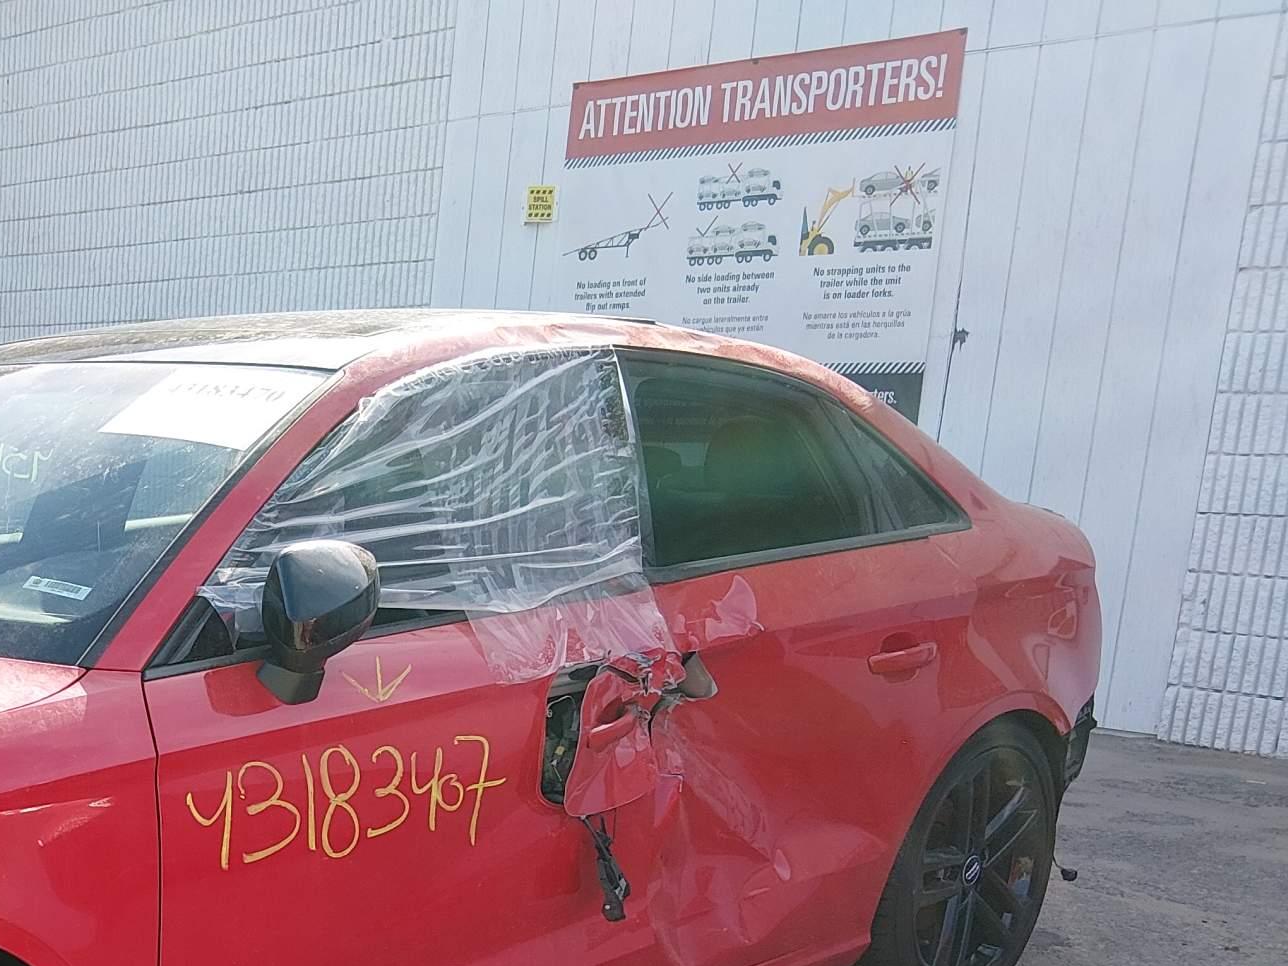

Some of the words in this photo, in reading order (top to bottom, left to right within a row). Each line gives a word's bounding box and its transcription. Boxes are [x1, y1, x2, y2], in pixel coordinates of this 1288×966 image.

[578, 84, 712, 140] ATTENTION
[721, 53, 948, 123] TRANSPORTERS!
[813, 267, 825, 276] No
[827, 266, 863, 277] strapping
[866, 264, 886, 274] units
[888, 265, 896, 273] to
[898, 263, 911, 272] the
[685, 274, 696, 283] No
[697, 274, 712, 282] side
[714, 273, 740, 283] loading
[742, 272, 775, 280] between
[820, 279, 843, 288] trailer
[845, 278, 868, 287] while
[871, 277, 883, 286] the
[885, 277, 902, 285] unit
[577, 281, 586, 289] No
[588, 280, 610, 290] loading
[639, 277, 647, 286] of
[697, 286, 711, 294] two
[713, 284, 730, 293] units
[732, 283, 760, 293] already
[575, 292, 597, 301] trailers
[599, 291, 613, 299] with
[615, 289, 646, 298] extended
[824, 291, 830, 300] is
[832, 292, 842, 300] on
[844, 289, 870, 299] loader
[872, 288, 894, 298] forks.
[714, 297, 725, 305] the
[586, 303, 596, 312] flip
[598, 302, 608, 310] out
[803, 312, 812, 320] No
